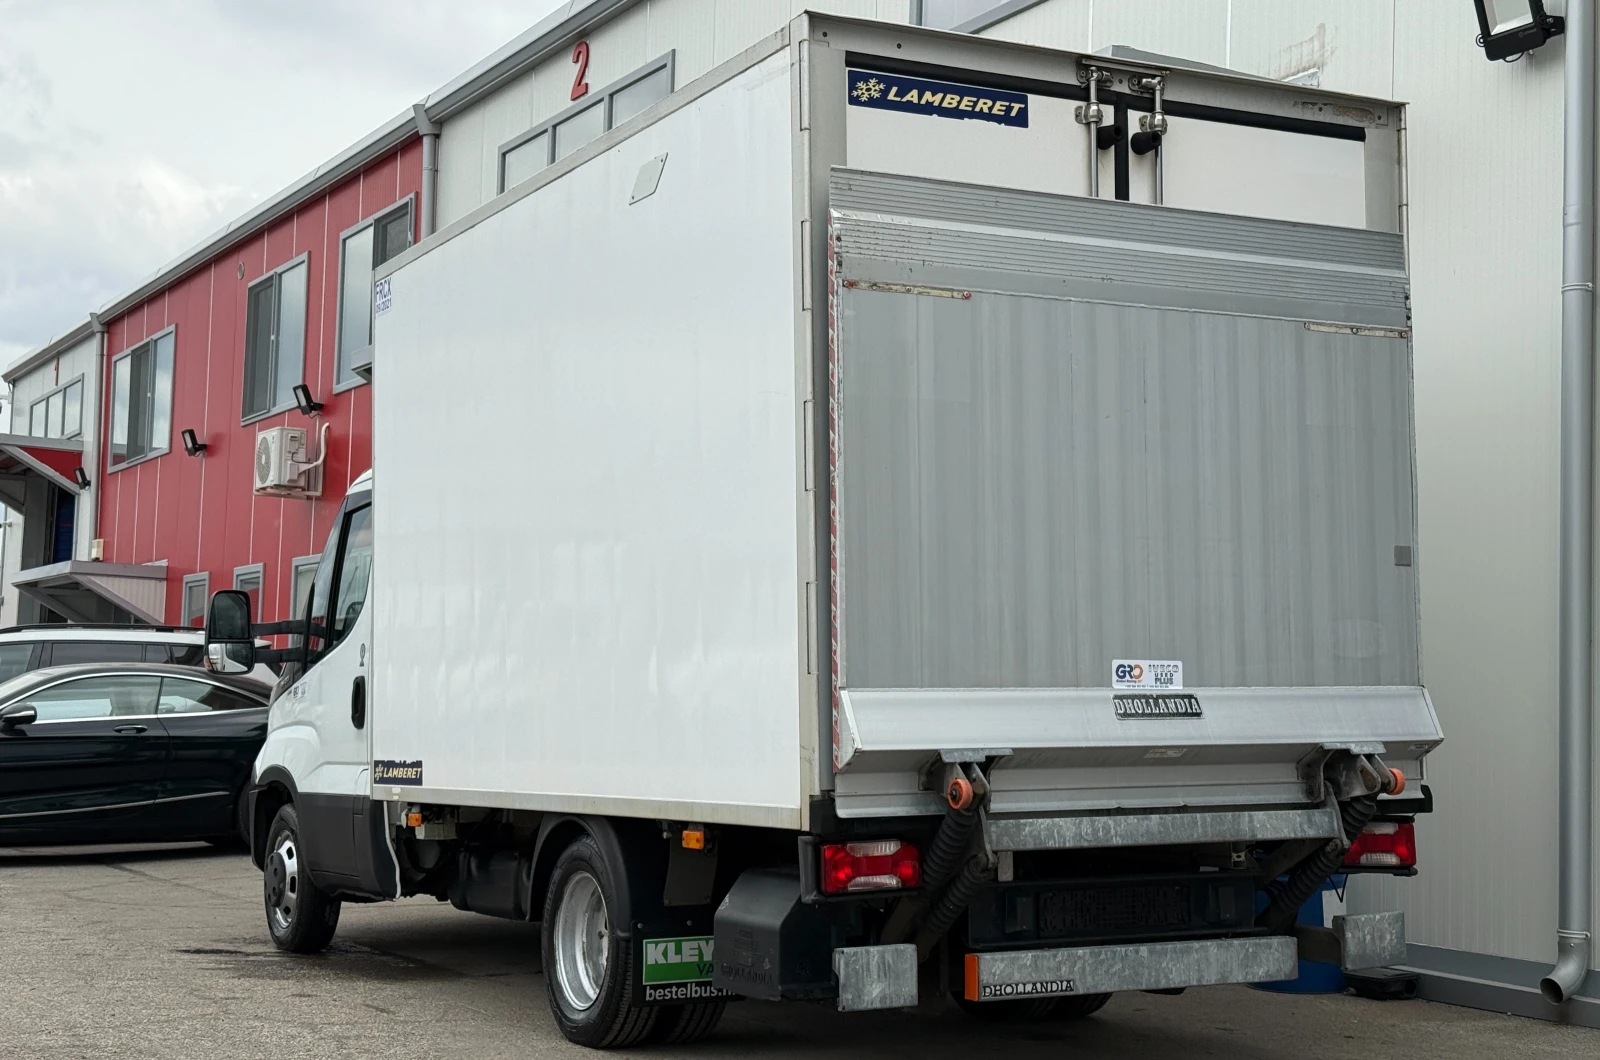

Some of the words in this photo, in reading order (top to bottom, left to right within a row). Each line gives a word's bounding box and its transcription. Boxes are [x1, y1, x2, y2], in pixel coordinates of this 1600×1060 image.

[570, 40, 589, 101] 2
[886, 86, 1026, 117] LAMBERET
[375, 276, 392, 303] FRCX
[1115, 664, 1144, 680] GRO
[1148, 664, 1180, 673] IVECO
[1154, 677, 1174, 685] PLUS
[1114, 698, 1202, 714] DHOLLANDIA
[383, 767, 422, 779] LAMBERET
[982, 980, 1075, 998] DHOLLANDIA
